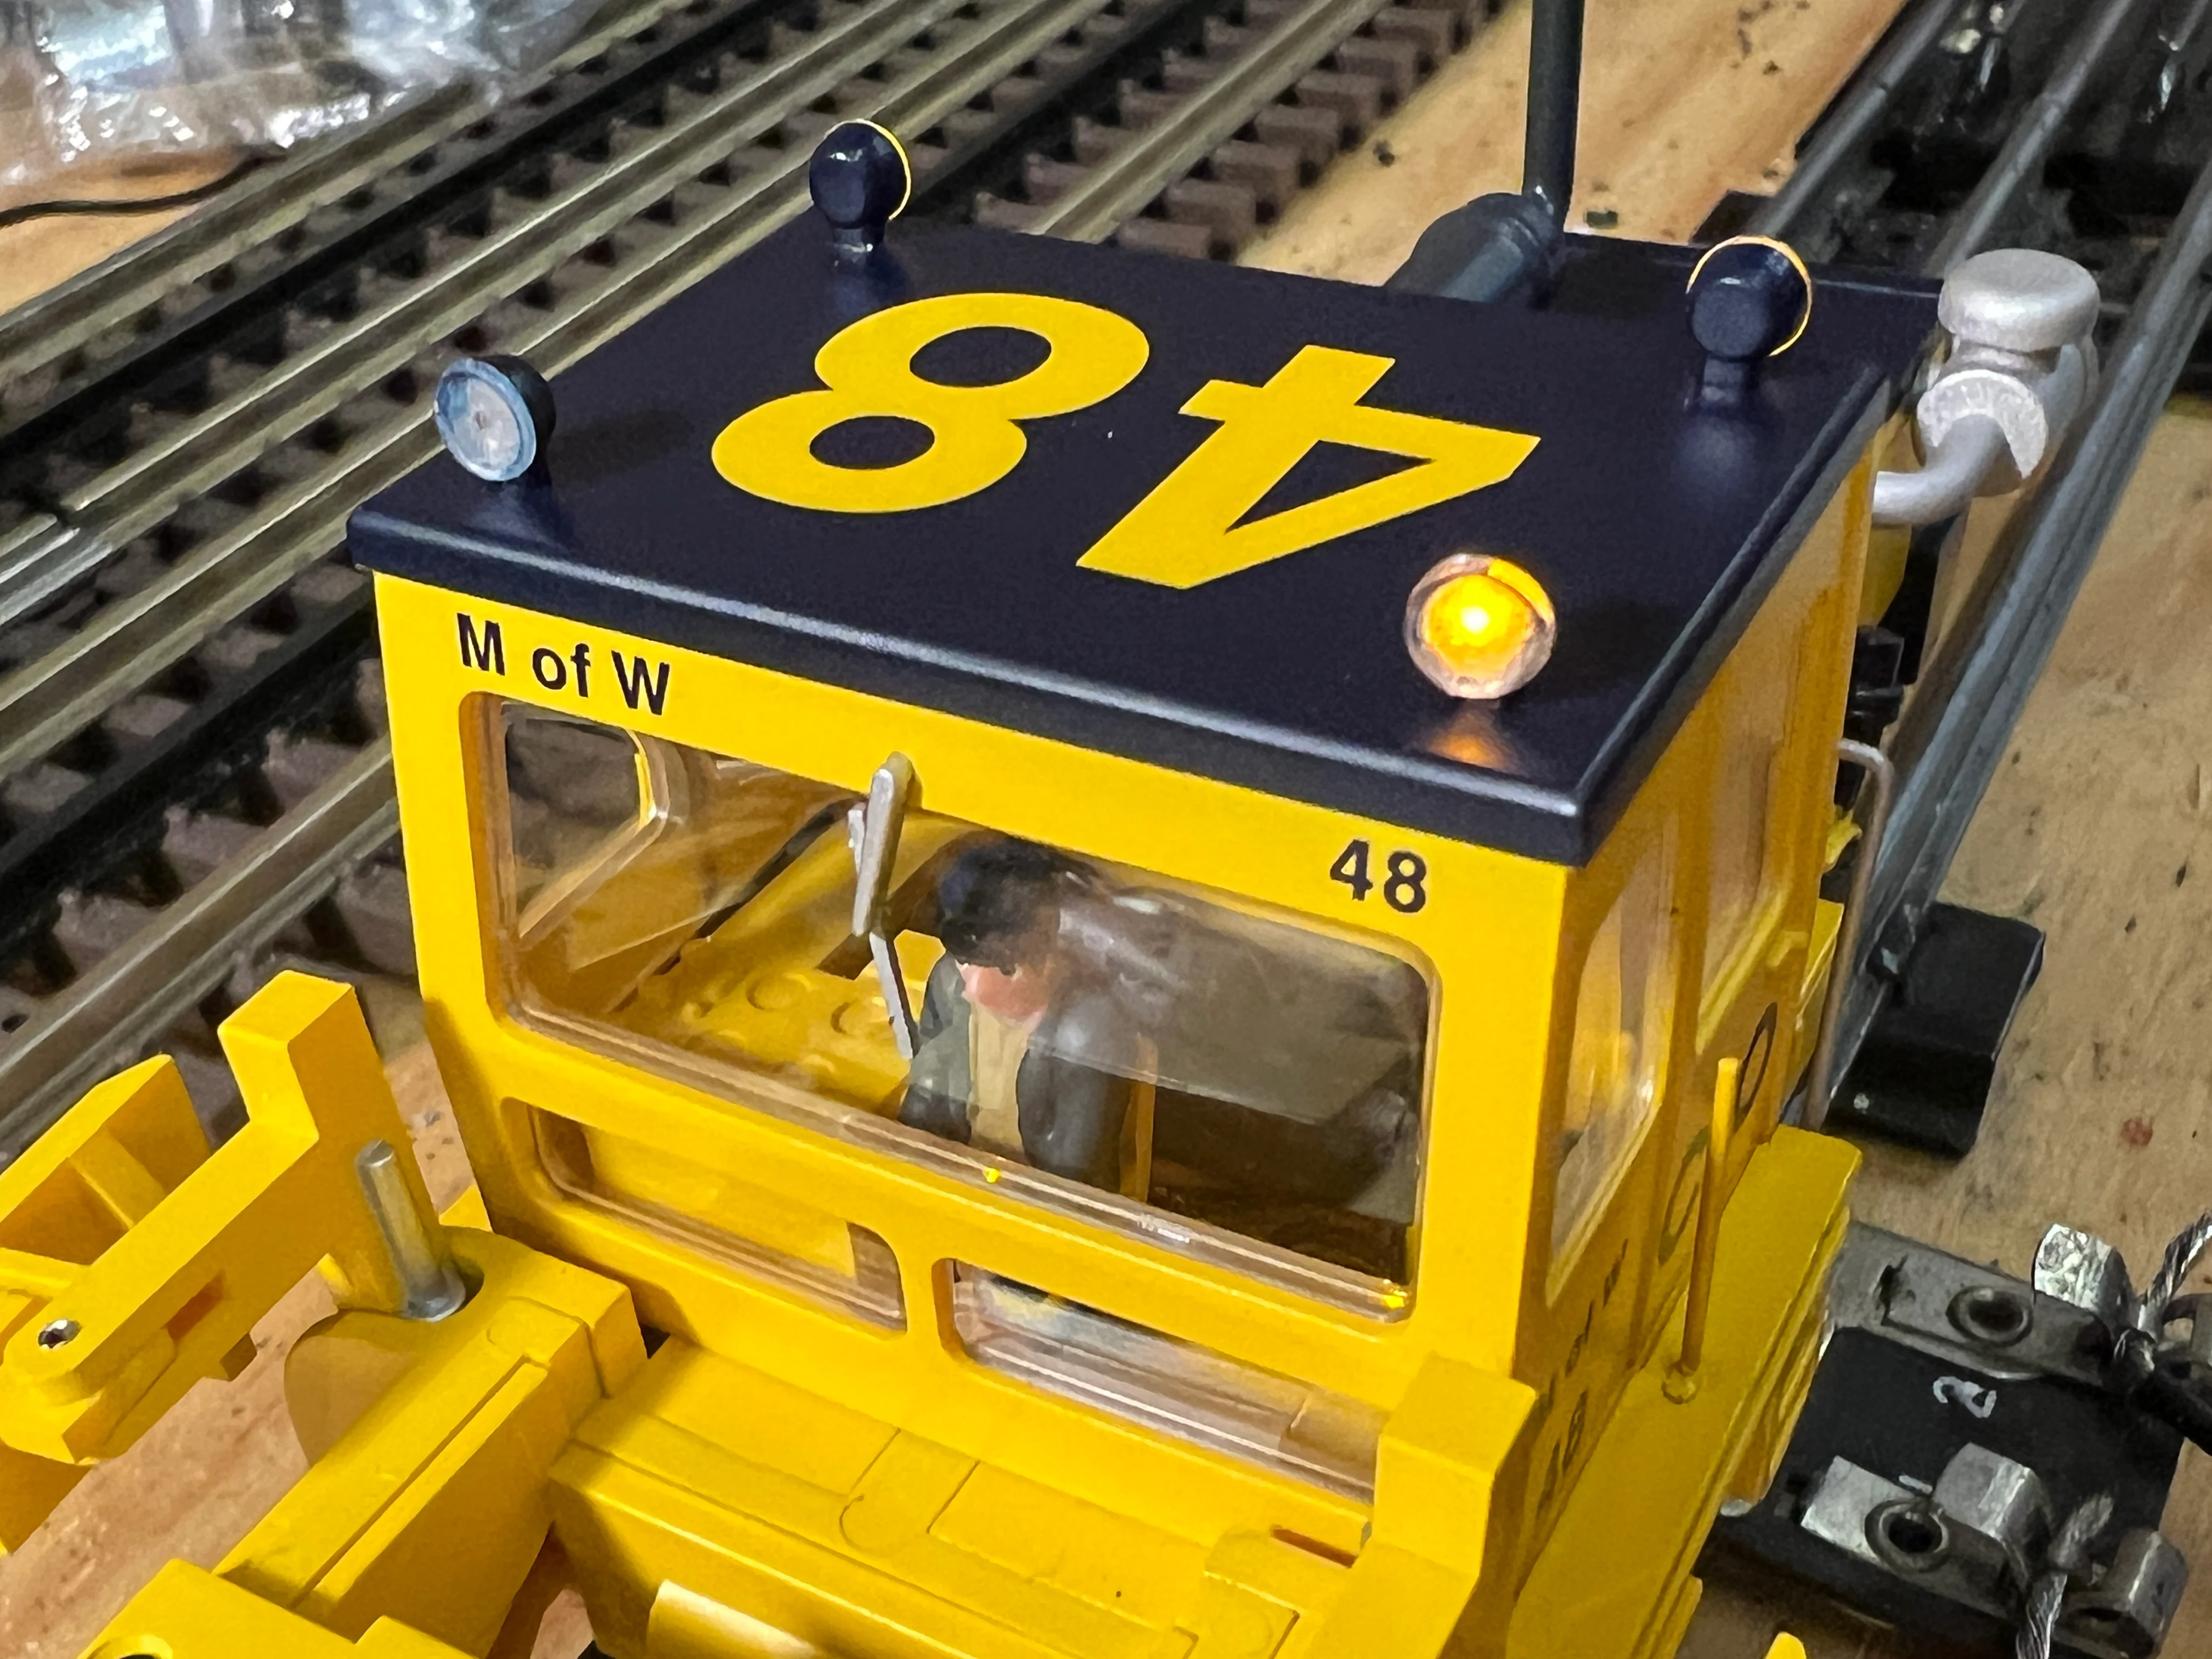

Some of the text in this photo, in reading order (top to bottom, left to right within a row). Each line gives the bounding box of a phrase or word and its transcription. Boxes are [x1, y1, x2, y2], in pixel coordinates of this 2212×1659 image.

[712, 292, 1542, 590] 48
[456, 612, 670, 715] M of W
[1329, 839, 1427, 913] 48
[1932, 1375, 1997, 1419] 2
